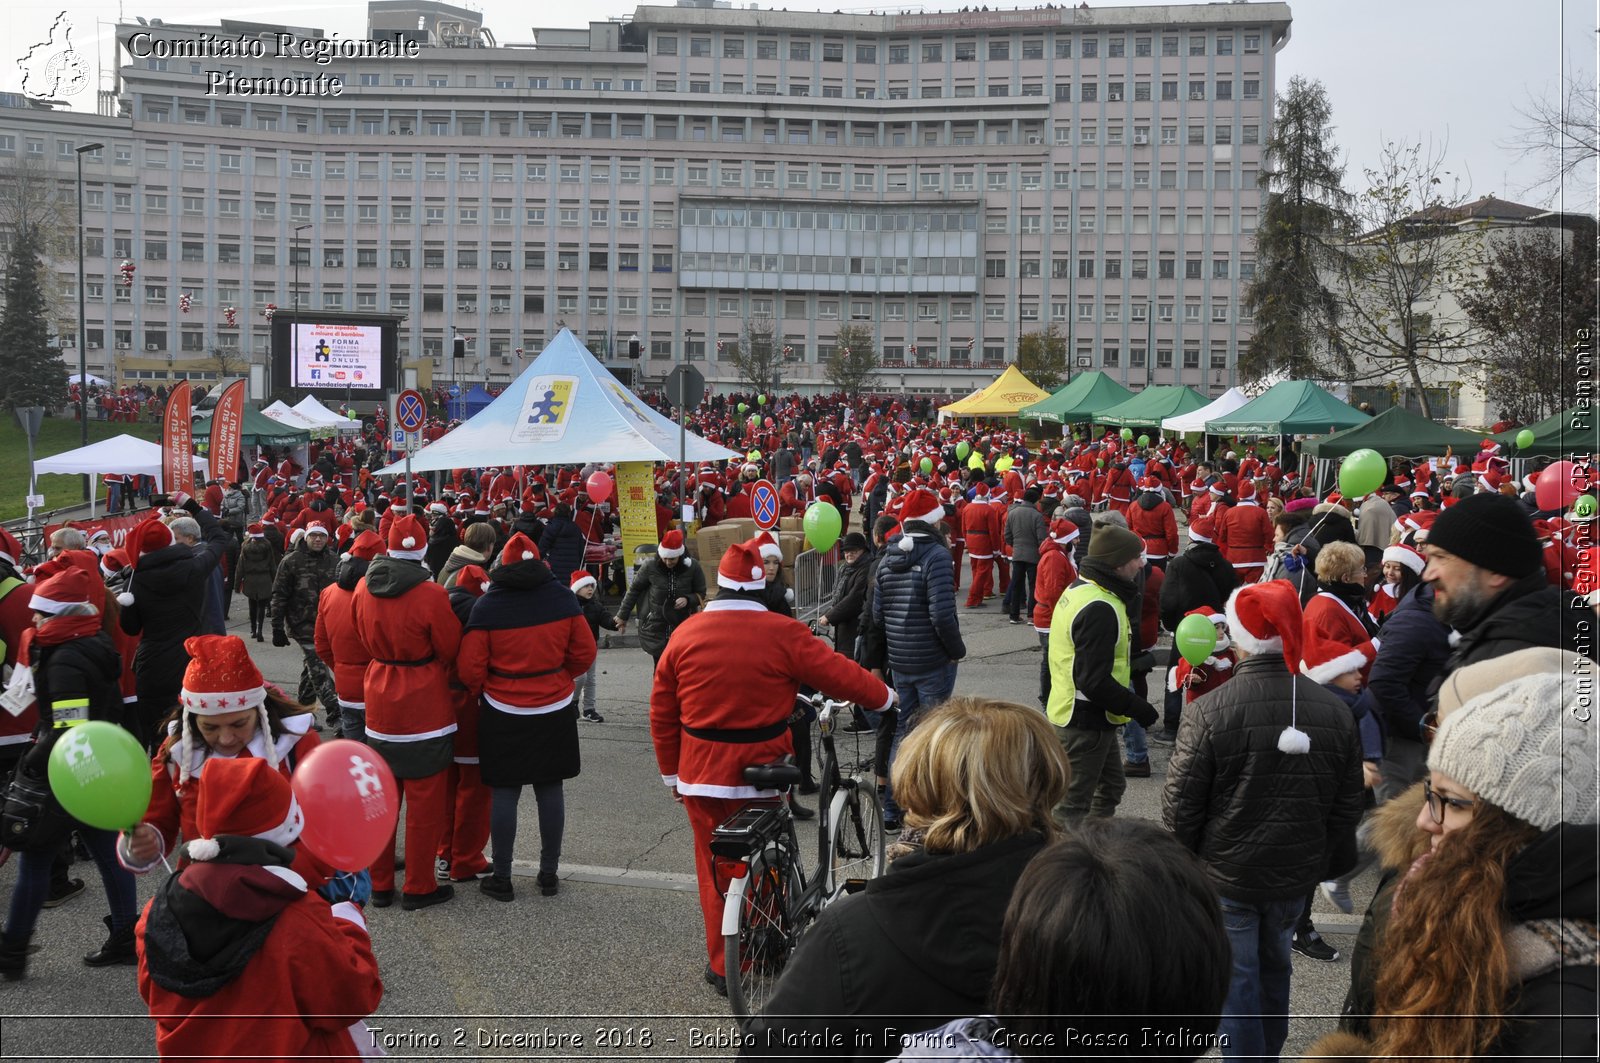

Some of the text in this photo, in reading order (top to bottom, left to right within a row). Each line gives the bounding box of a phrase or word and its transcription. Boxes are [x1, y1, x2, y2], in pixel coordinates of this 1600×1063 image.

[224, 396, 232, 408] 24
[172, 404, 178, 416] 24
[222, 410, 230, 422] SU
[172, 419, 179, 432] SU
[228, 420, 236, 431] SU
[181, 428, 187, 441] SU
[220, 424, 228, 441] ORE
[220, 444, 226, 455] 24
[227, 434, 235, 462] GIORNI
[173, 457, 180, 469] 24
